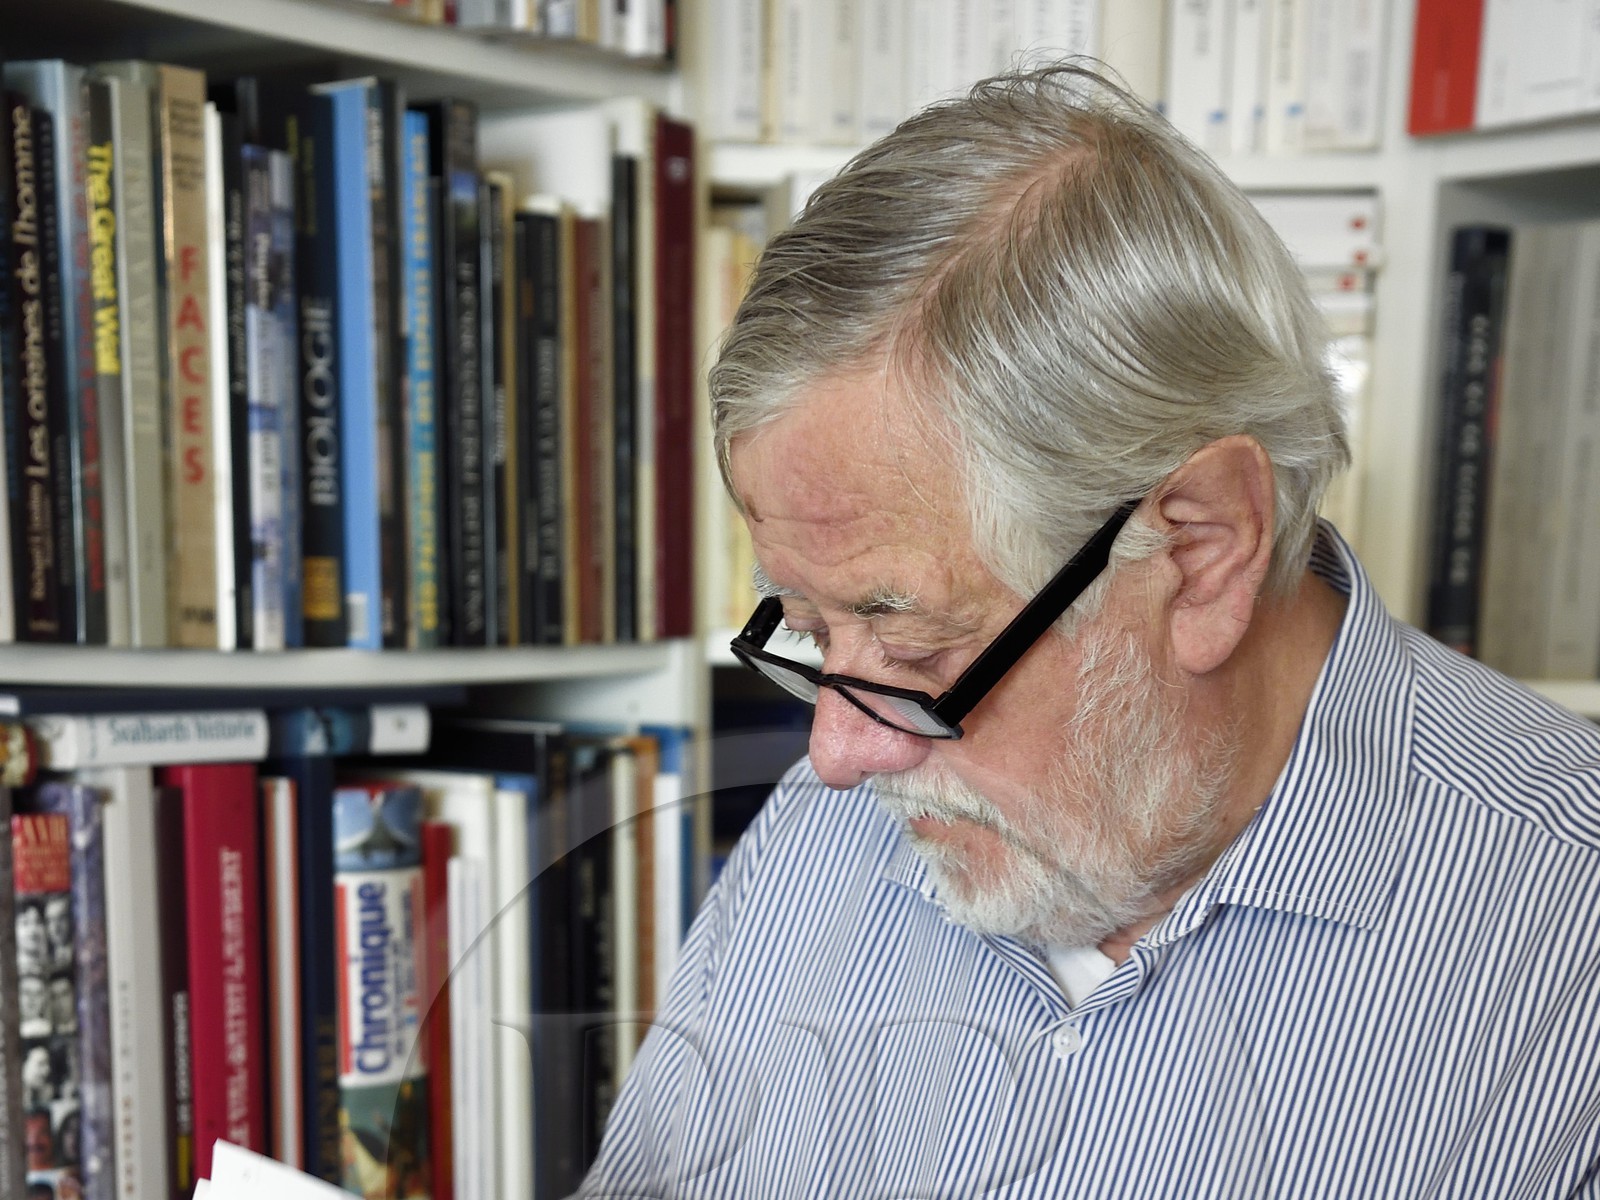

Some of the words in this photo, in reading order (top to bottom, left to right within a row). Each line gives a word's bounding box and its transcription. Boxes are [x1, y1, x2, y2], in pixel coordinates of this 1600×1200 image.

[11, 104, 39, 246] l'homme
[86, 140, 114, 204] The
[13, 250, 42, 296] de
[88, 206, 117, 299] Great
[19, 299, 49, 421] origines
[93, 304, 121, 375] Wall
[175, 246, 207, 484] FACES
[22, 424, 50, 478] Les
[302, 297, 339, 506] BIOLOGIE
[350, 882, 391, 1076] Chronique
